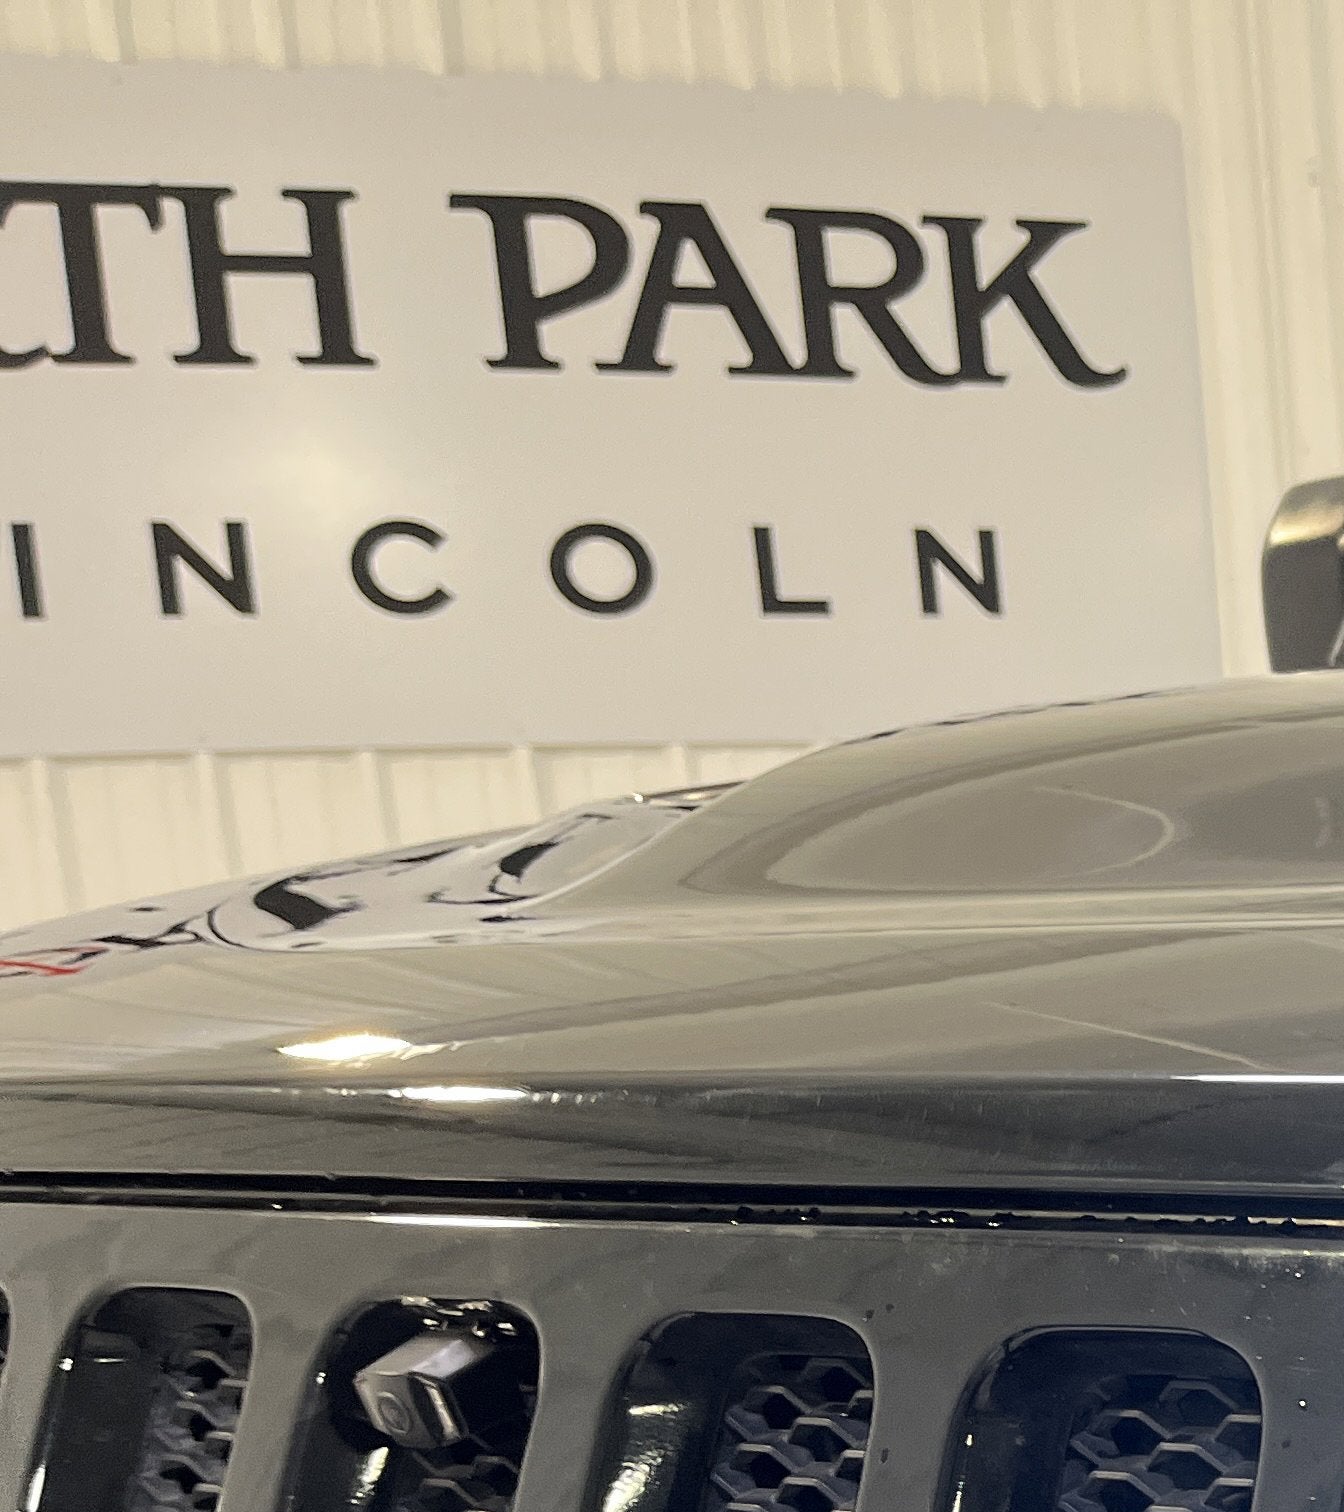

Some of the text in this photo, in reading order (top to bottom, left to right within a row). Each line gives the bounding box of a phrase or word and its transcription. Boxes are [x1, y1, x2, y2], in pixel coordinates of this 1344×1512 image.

[0, 181, 1127, 388] TH PARK
[11, 519, 1001, 619] INCOLN
